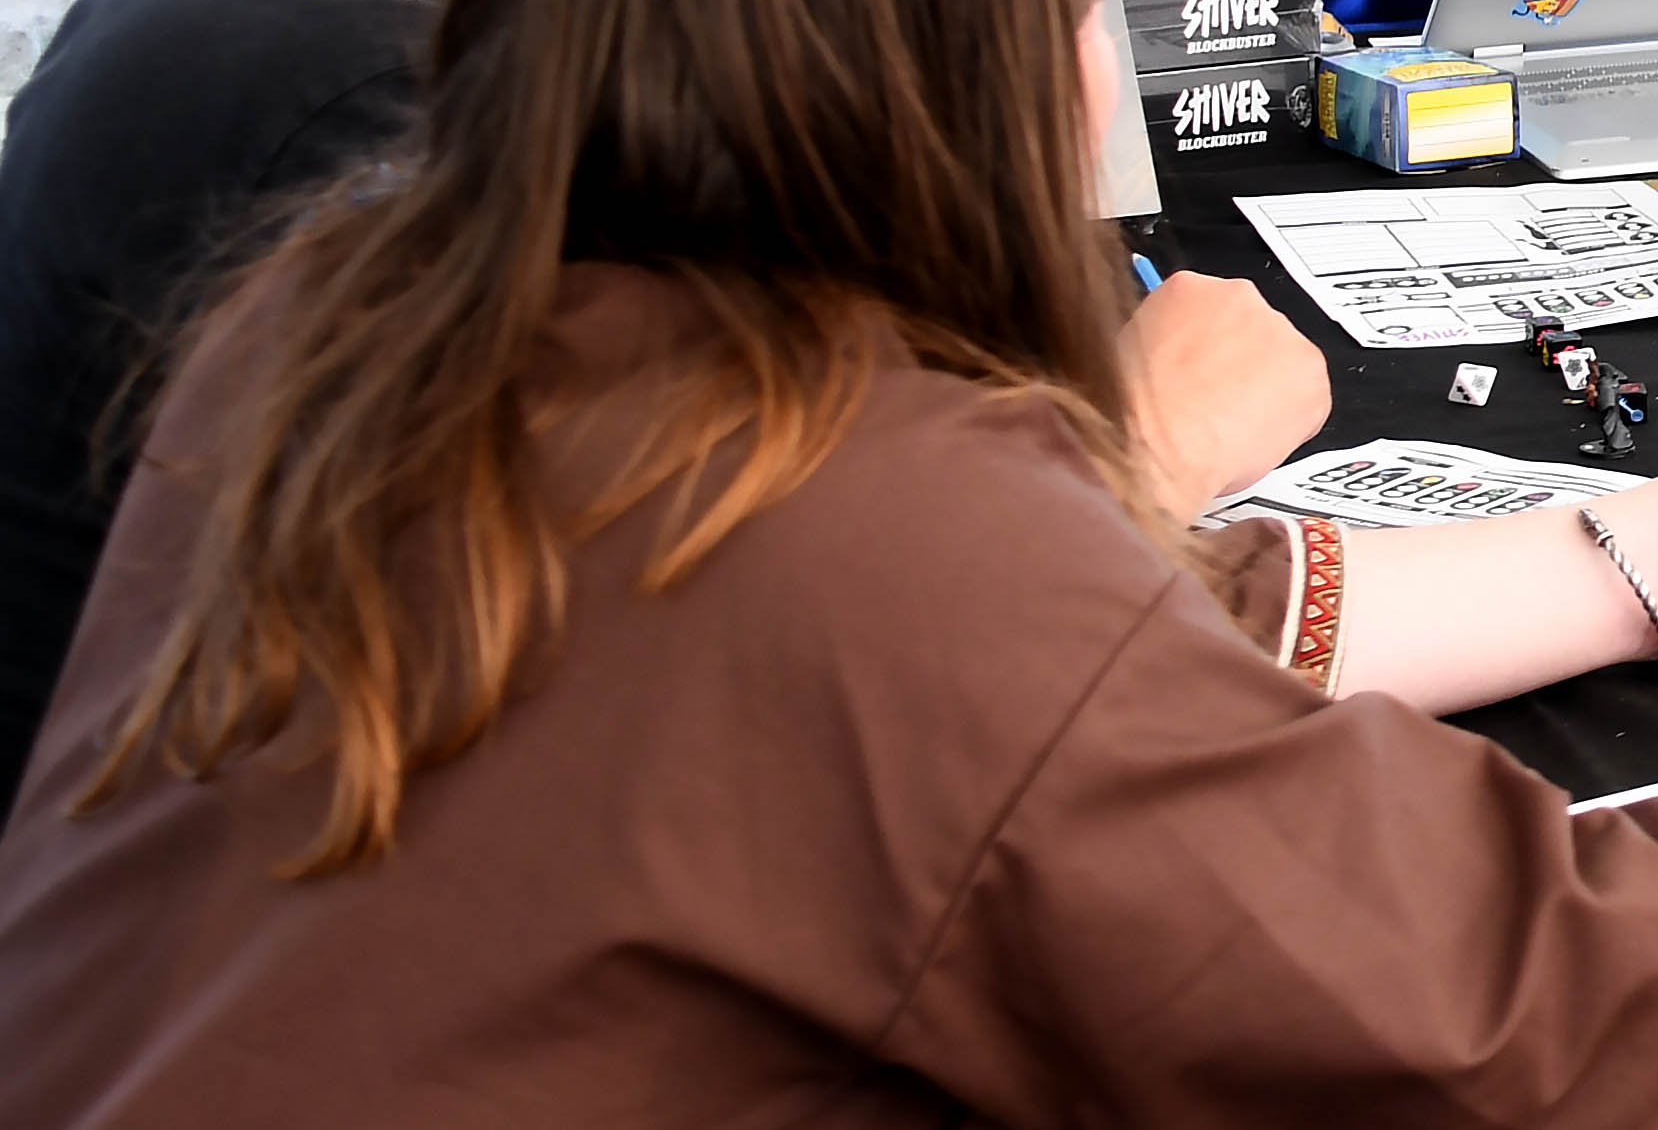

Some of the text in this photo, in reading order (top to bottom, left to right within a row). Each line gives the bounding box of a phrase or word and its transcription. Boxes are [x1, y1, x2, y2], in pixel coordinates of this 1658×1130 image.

[1186, 33, 1276, 55] BLOCKBUSTER
[1172, 79, 1271, 135] SHIVER
[1177, 130, 1268, 152] BLOCKBUSTER
